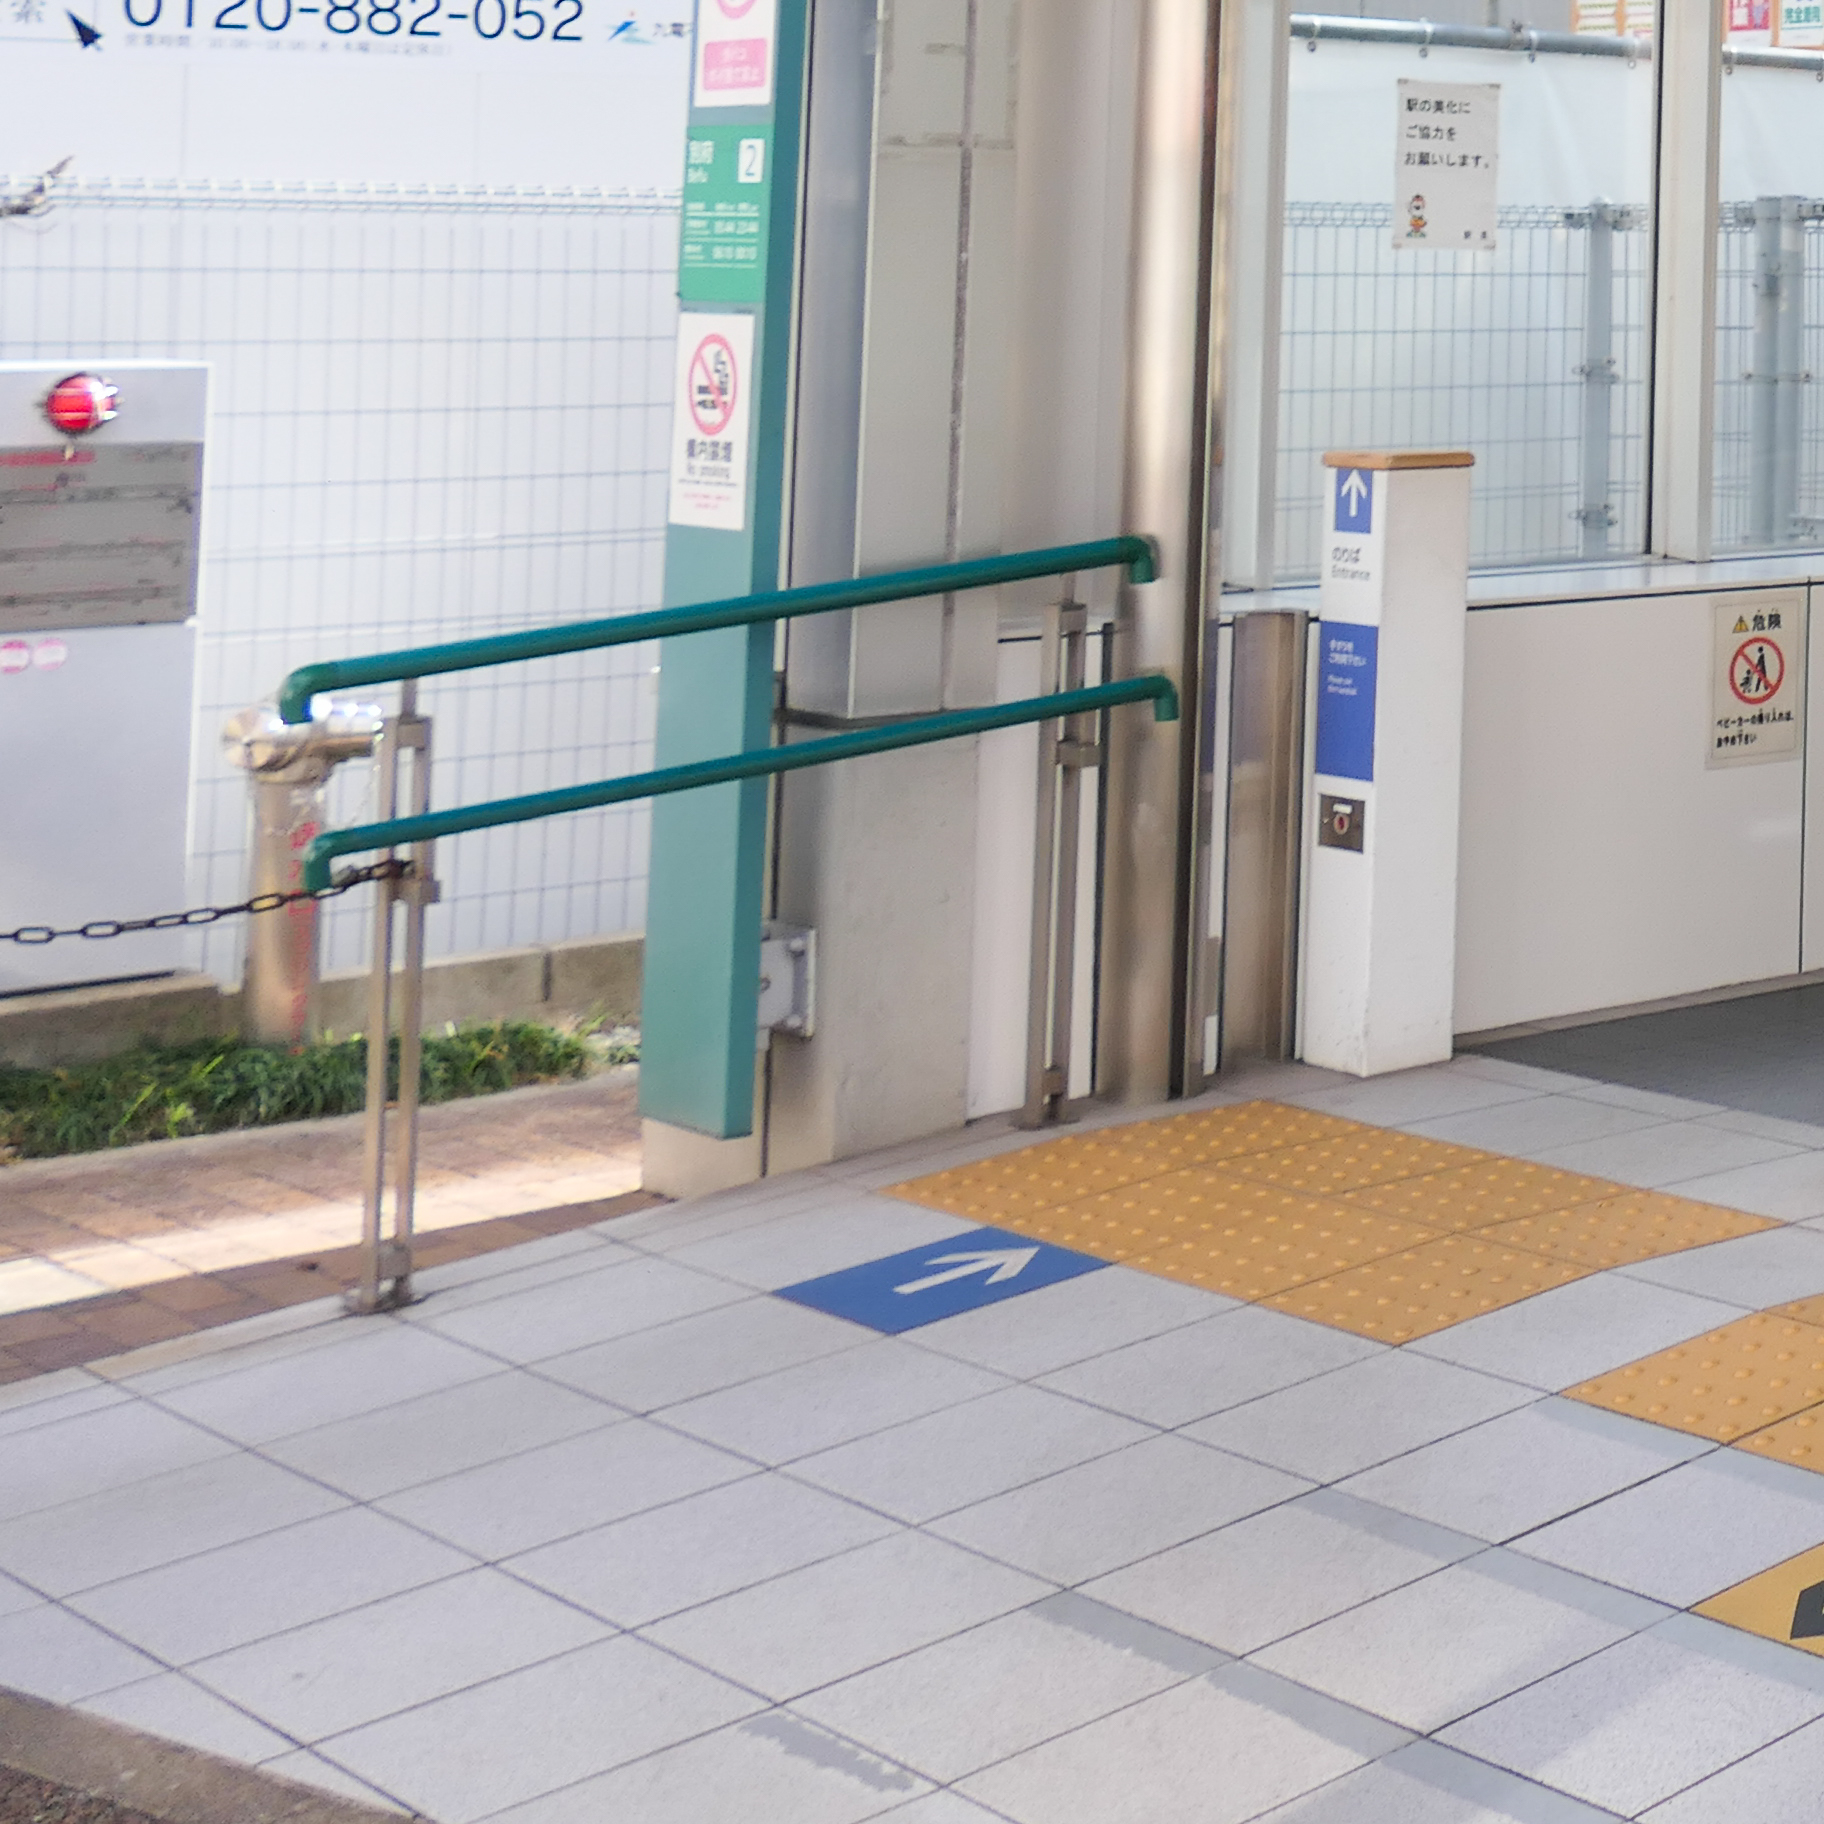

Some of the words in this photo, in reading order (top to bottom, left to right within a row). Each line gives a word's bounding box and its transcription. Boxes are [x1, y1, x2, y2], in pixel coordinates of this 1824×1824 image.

[1405, 97, 1472, 114] 駅の美化に
[1405, 123, 1457, 142] ご協力を
[744, 143, 757, 177] 2
[1404, 151, 1490, 169] お願いします。
[1752, 613, 1782, 631] 危険
